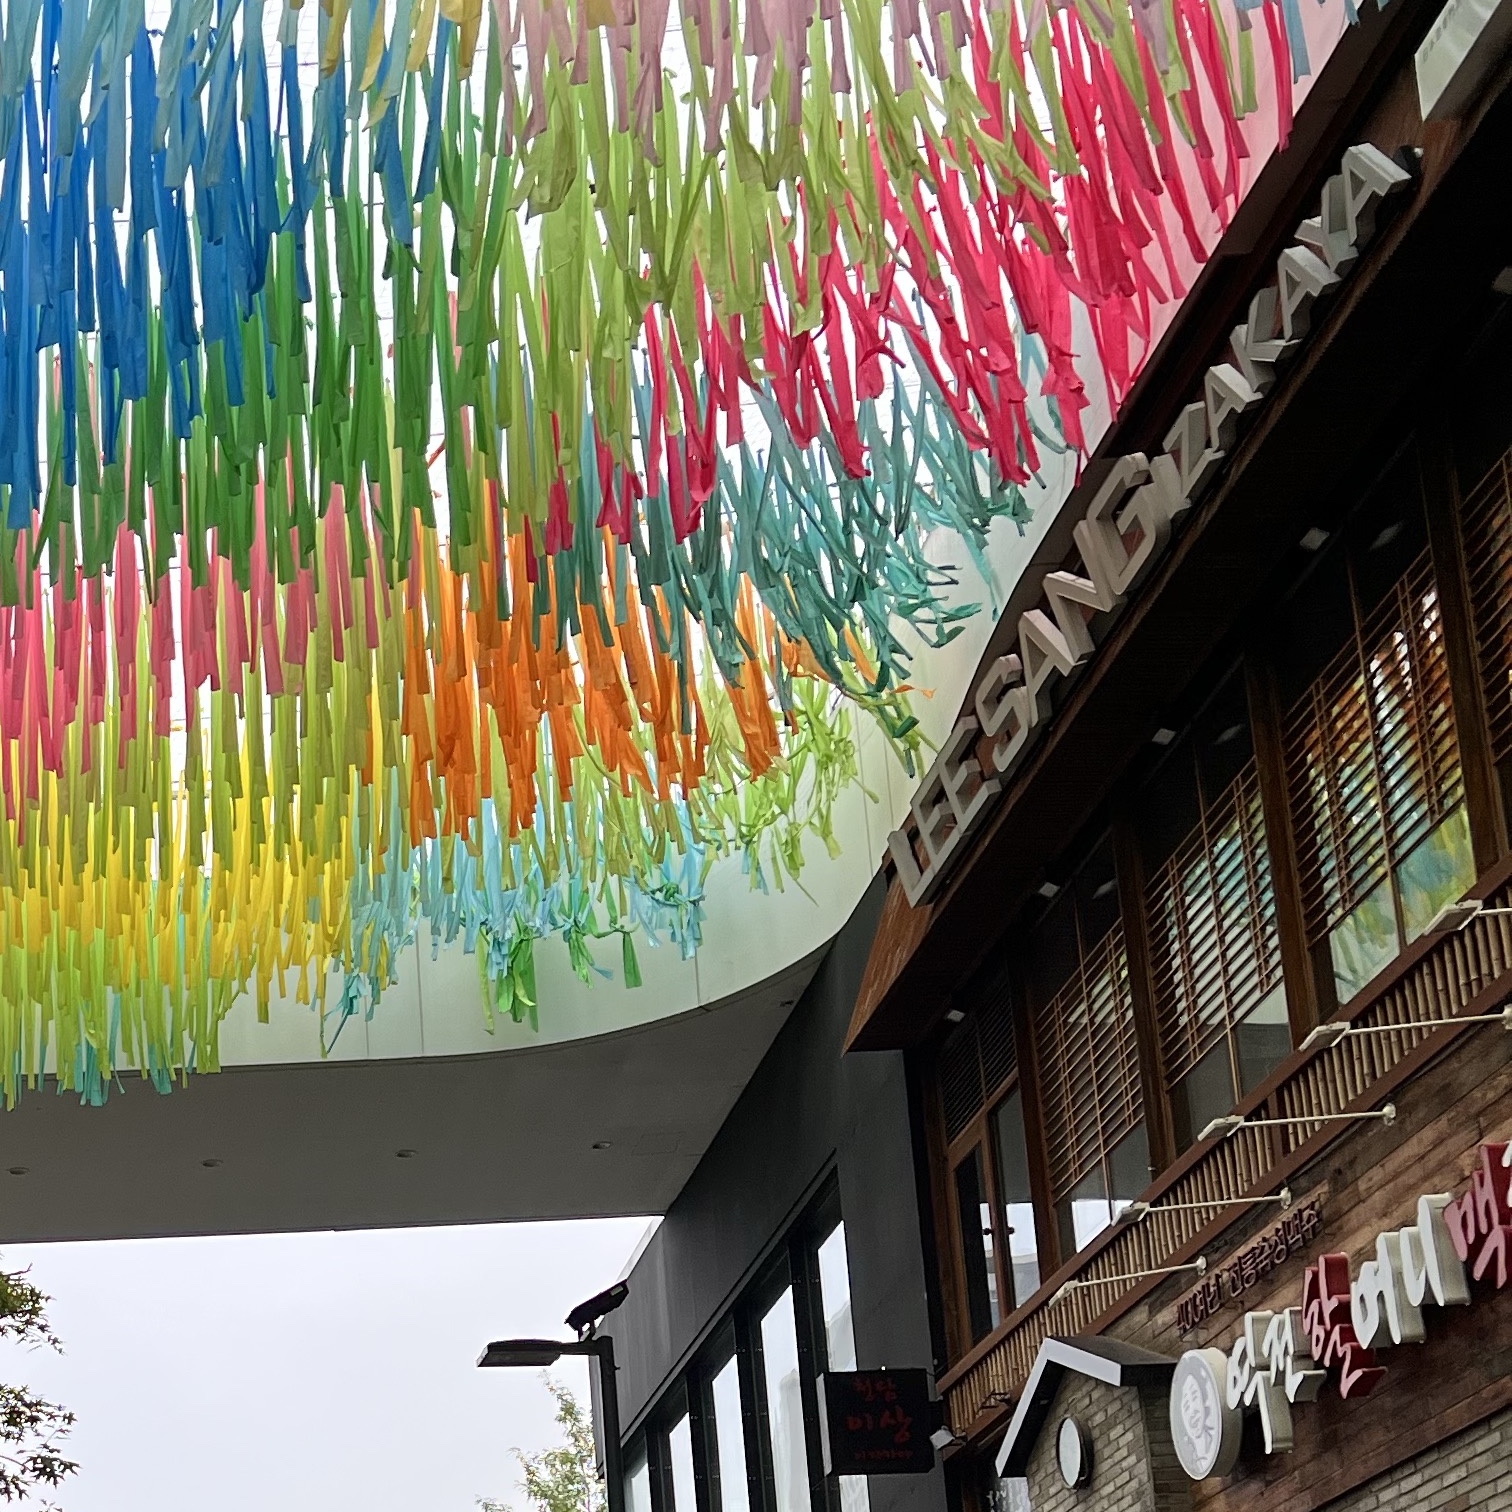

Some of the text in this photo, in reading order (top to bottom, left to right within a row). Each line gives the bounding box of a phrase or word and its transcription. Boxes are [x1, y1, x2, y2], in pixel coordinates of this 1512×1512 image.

[888, 142, 1411, 908] LEE SANG IZAKAYA
